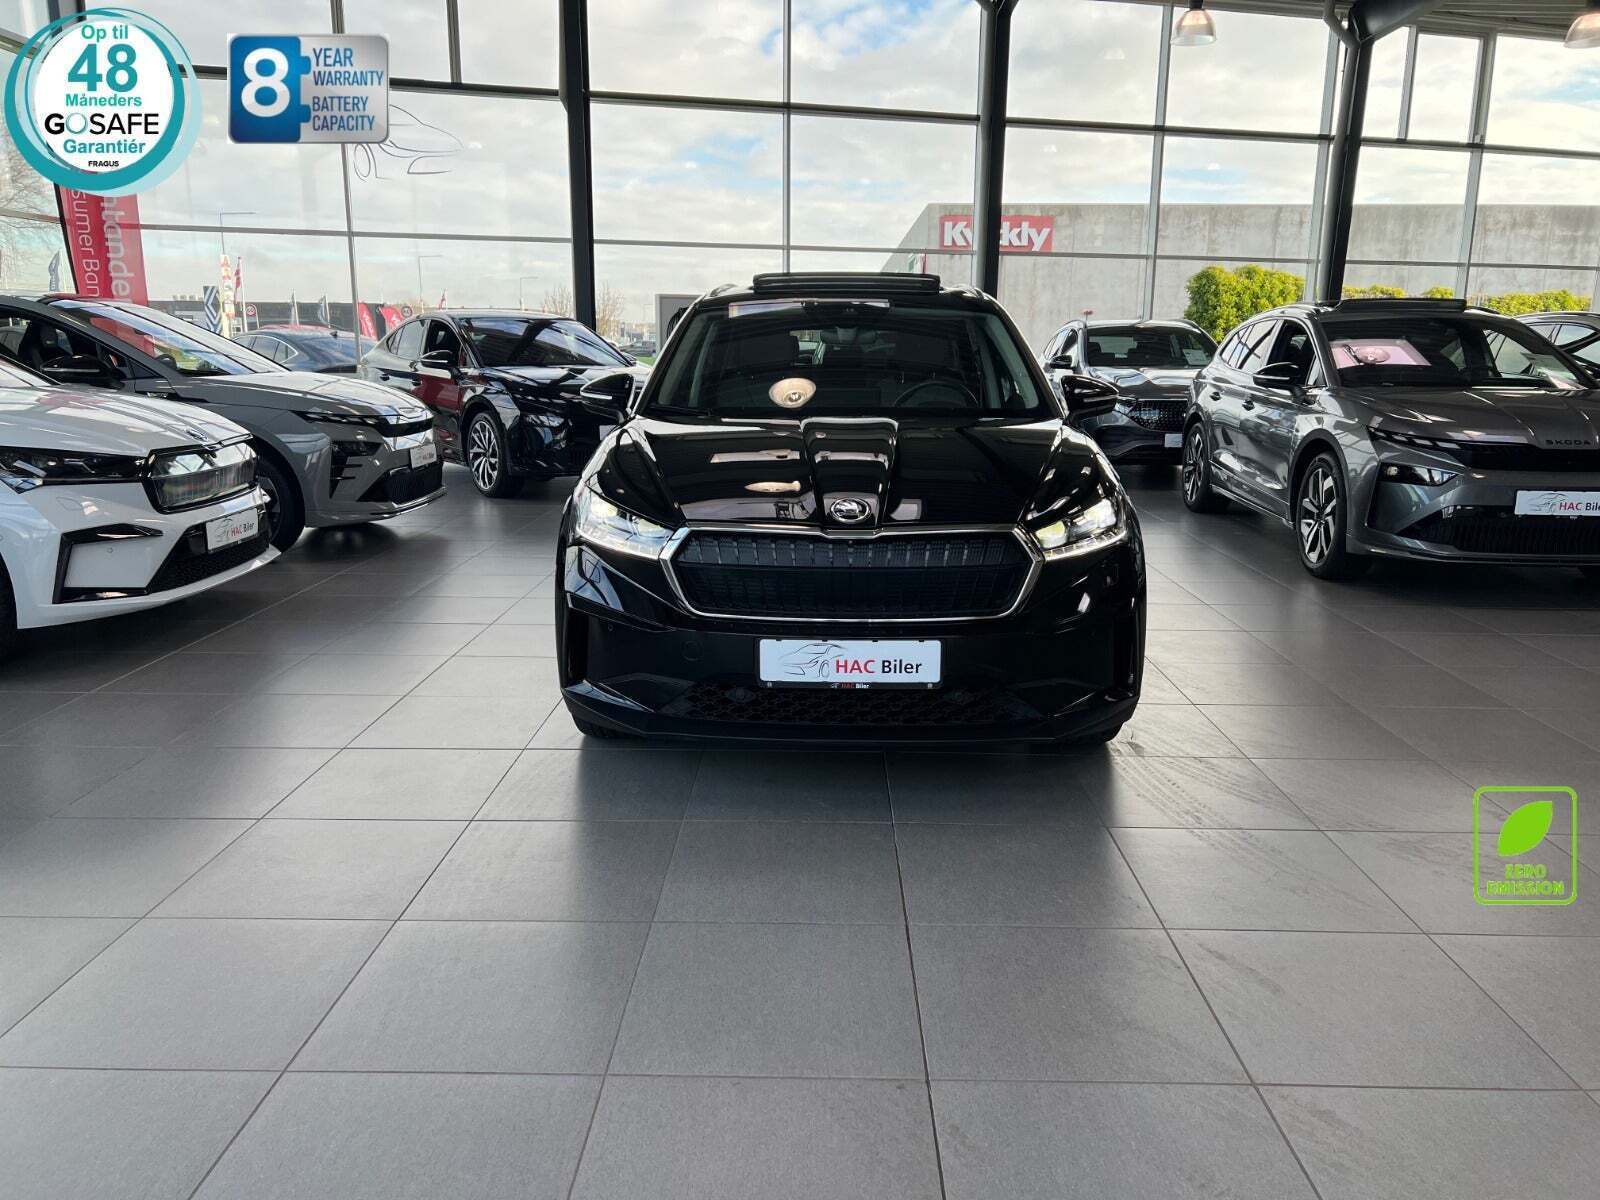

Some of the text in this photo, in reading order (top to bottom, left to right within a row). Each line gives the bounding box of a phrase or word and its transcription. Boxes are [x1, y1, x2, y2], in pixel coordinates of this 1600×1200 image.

[943, 221, 1051, 252] Kvkly
[100, 196, 136, 302] ntande
[1559, 502, 1582, 511] HAC
[835, 658, 923, 674] HAC Biler
